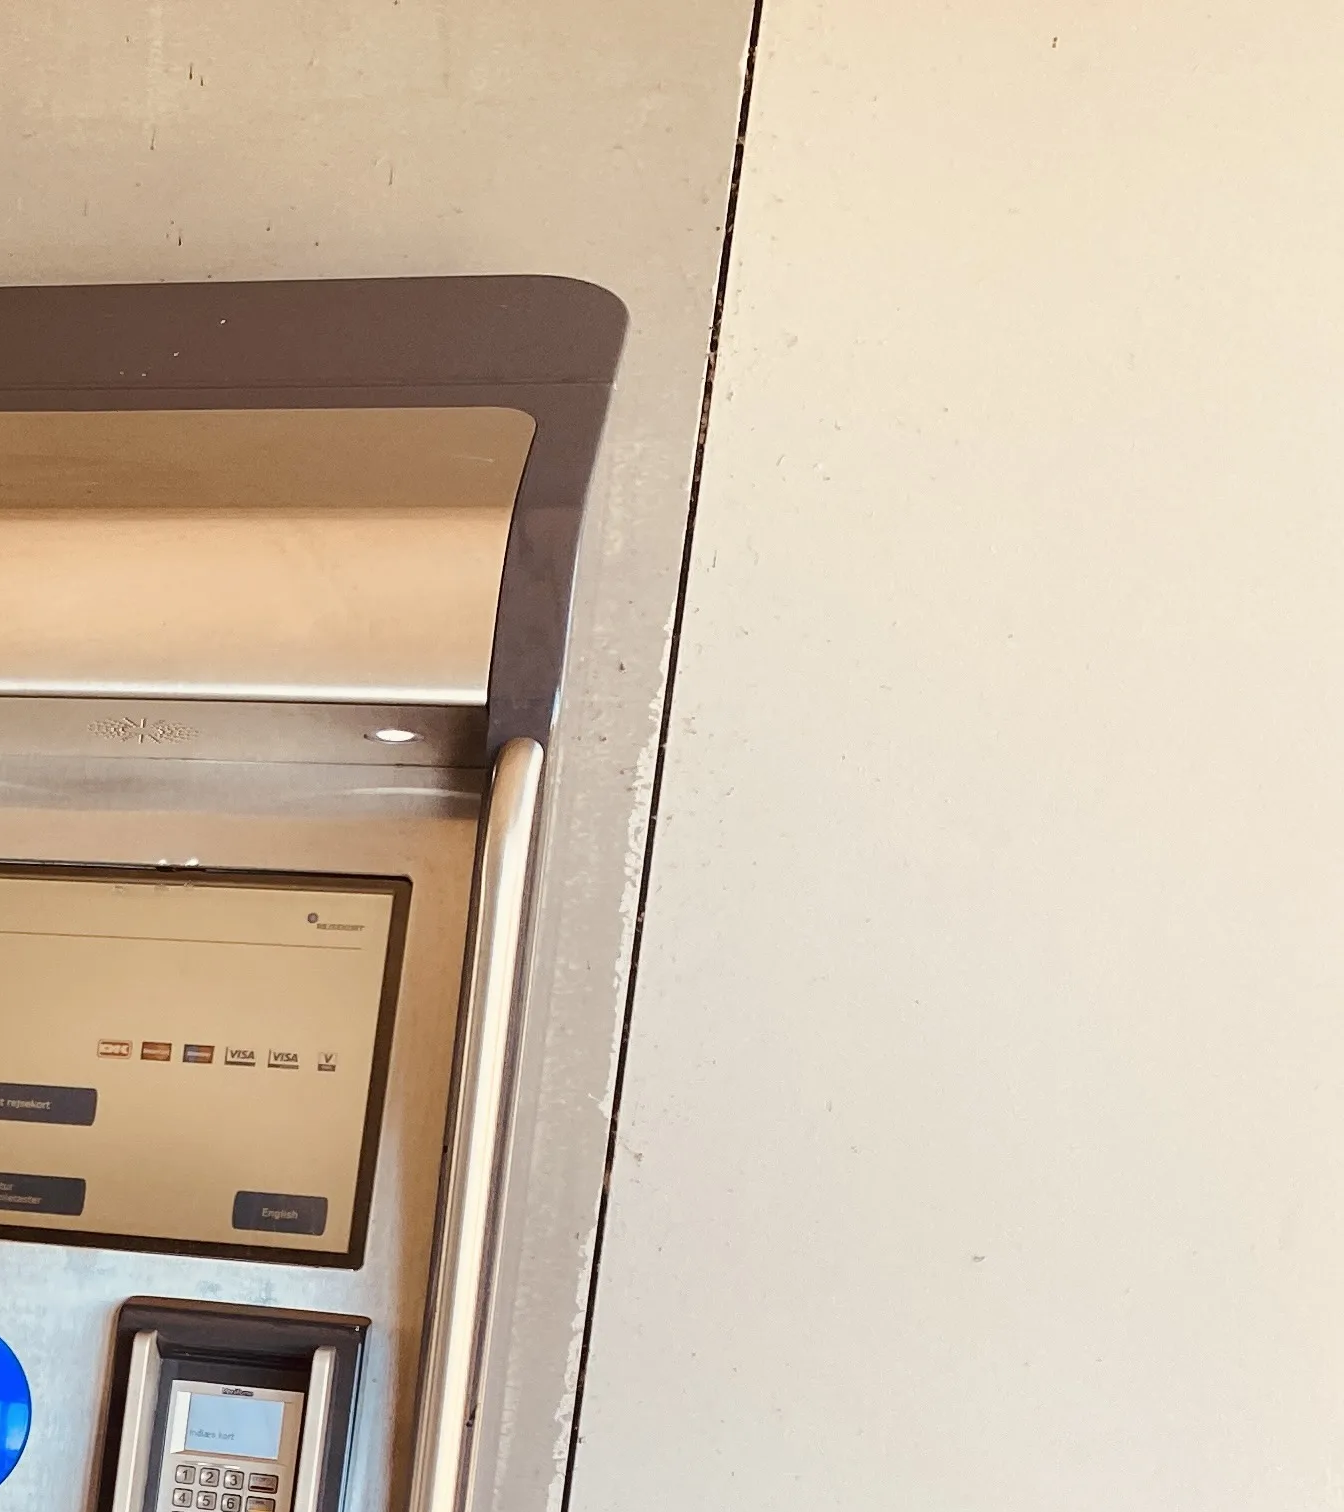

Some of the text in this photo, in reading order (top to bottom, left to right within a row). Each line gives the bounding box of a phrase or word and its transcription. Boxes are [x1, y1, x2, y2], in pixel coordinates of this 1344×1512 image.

[230, 1049, 255, 1060] VISA
[273, 1052, 299, 1063] VISA
[182, 1469, 188, 1481] 1
[205, 1471, 214, 1484] 2
[230, 1474, 238, 1486] 3
[178, 1492, 186, 1504] 4
[202, 1495, 211, 1507] 5
[226, 1497, 235, 1510] 6
